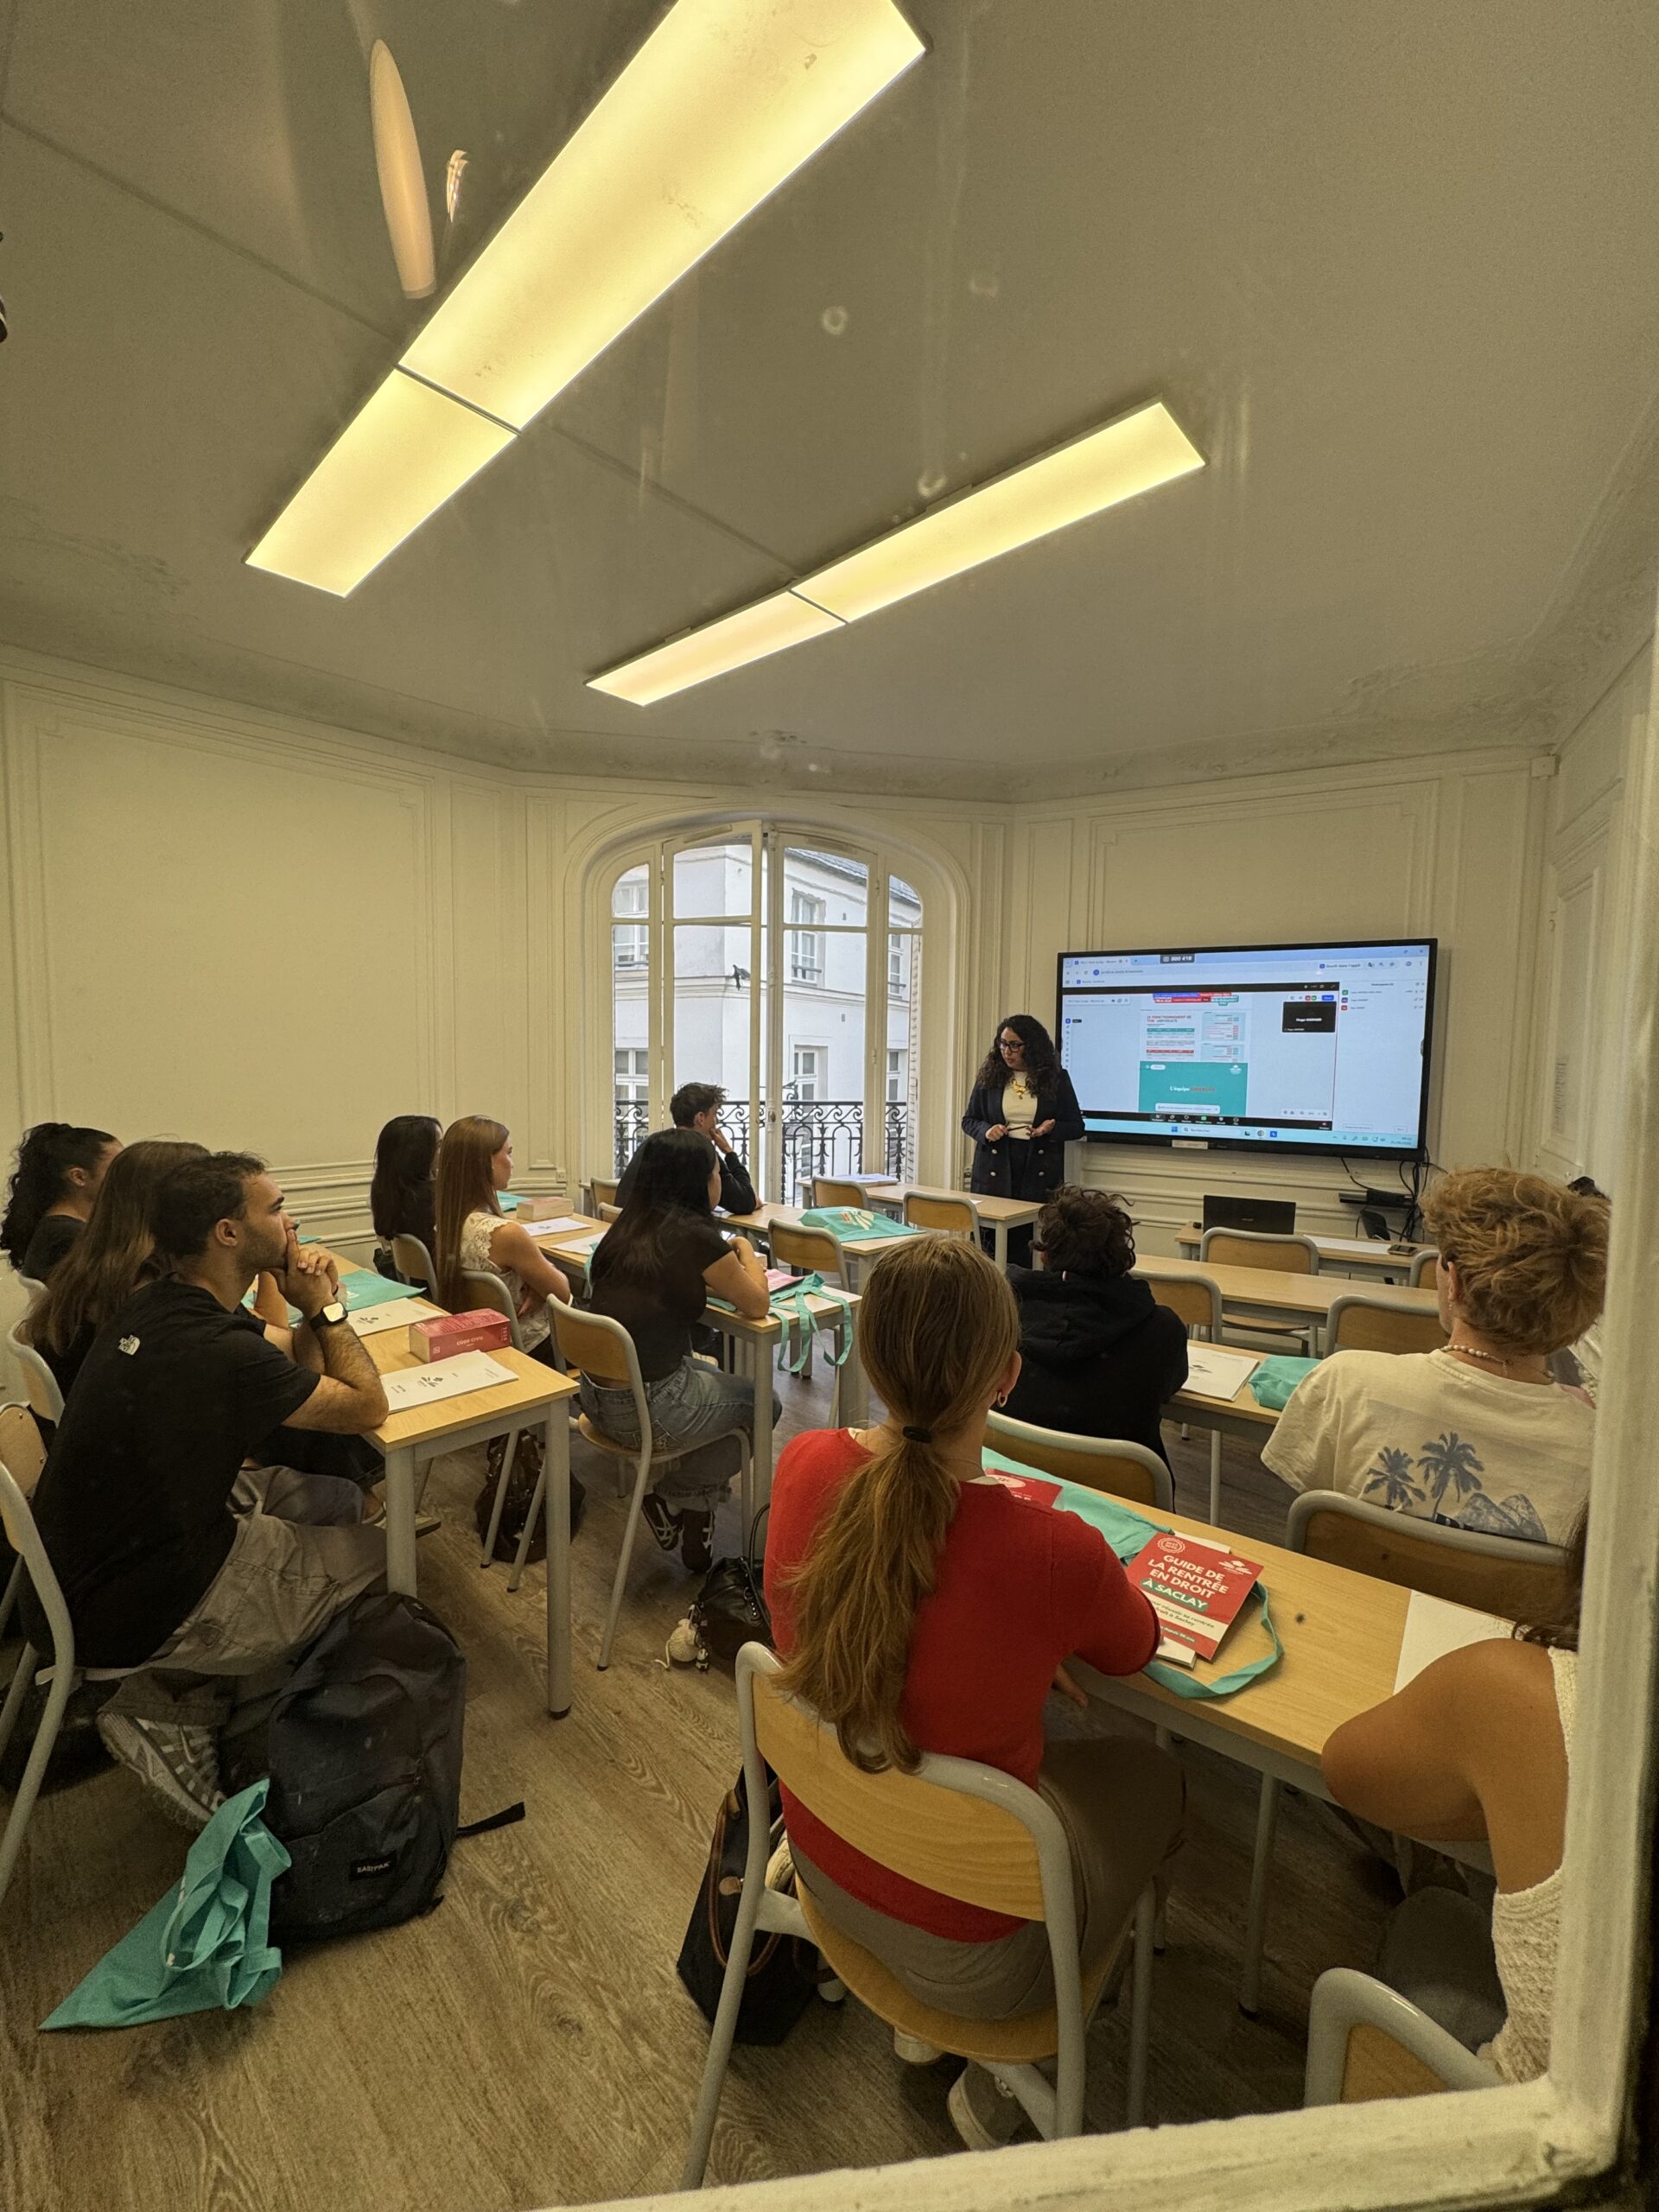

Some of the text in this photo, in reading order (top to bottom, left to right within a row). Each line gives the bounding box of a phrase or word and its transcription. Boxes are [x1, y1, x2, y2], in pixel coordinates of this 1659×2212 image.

[1147, 1559, 1165, 1570] LA
[1166, 1566, 1230, 1594] RENTRÉE
[1163, 1554, 1205, 1573] GUIDE
[1205, 1569, 1225, 1581] DE
[1142, 1578, 1208, 1609] À SACLAY
[1149, 1569, 1216, 1599] EN DROIT
[357, 1862, 390, 1873] EASTPAK
